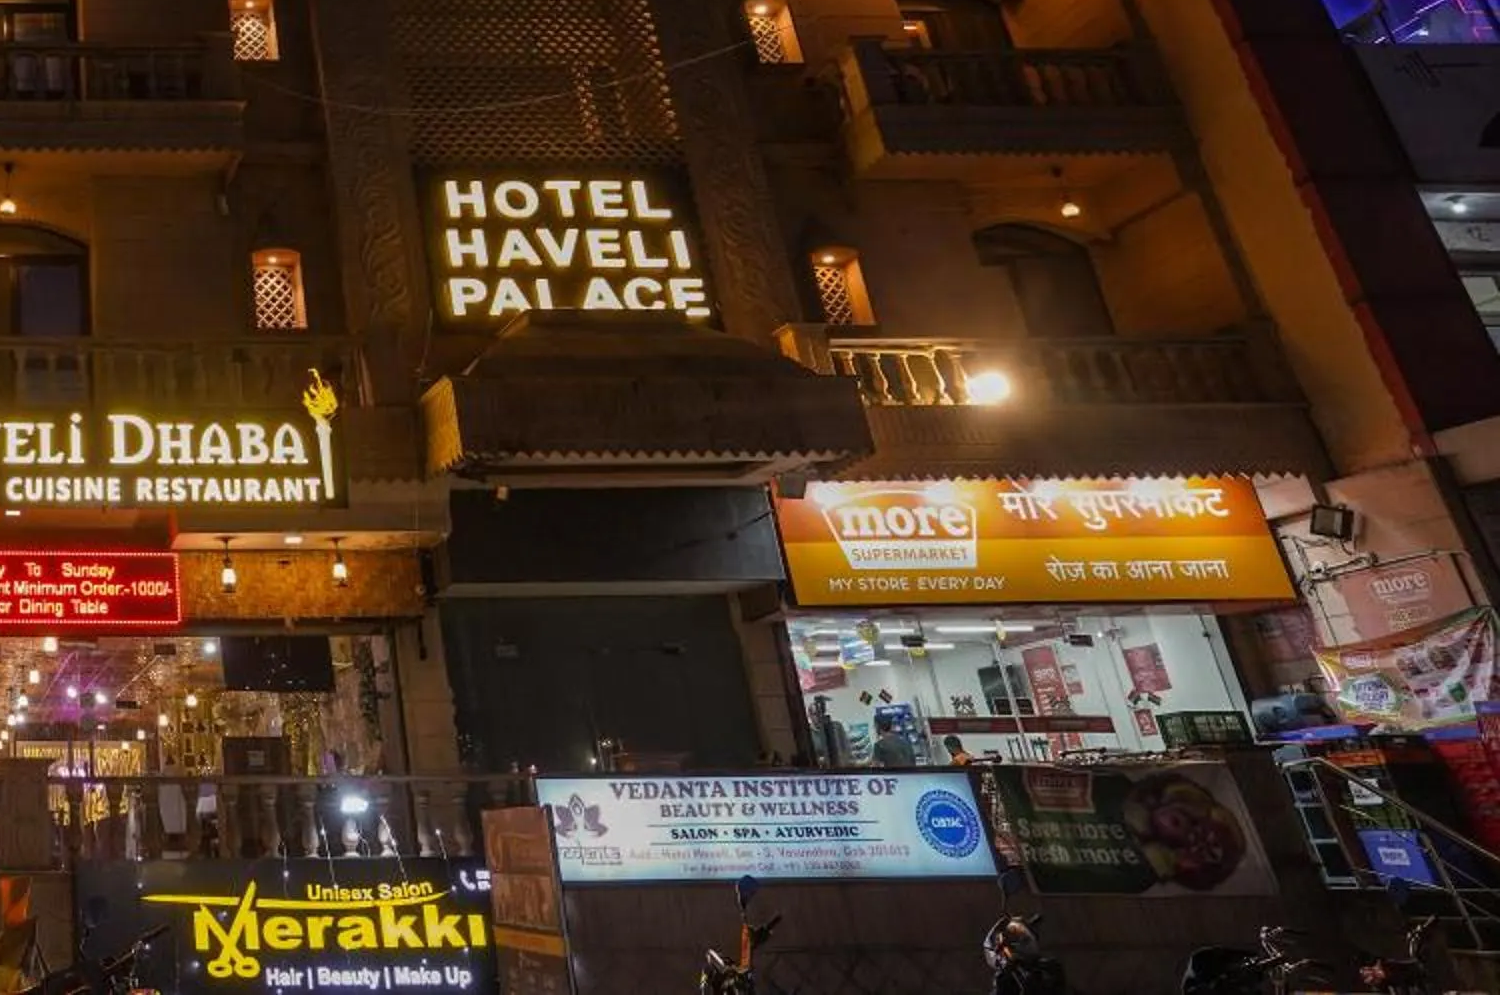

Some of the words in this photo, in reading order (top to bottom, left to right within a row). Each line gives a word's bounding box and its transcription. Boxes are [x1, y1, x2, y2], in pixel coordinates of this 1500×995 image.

[444, 180, 673, 219] HOTEL
[445, 228, 691, 269] HAVELI
[449, 277, 711, 316] PALACE
[107, 413, 309, 466] DHABA
[5, 477, 121, 501] CUISINE
[136, 477, 321, 502] RESTAURANT
[836, 504, 969, 537] more
[850, 546, 969, 563] SUPERMARKET
[24, 562, 42, 577] To
[61, 562, 116, 581] Sunday
[1089, 560, 1120, 580] का
[1125, 560, 1174, 580] आना
[1176, 559, 1230, 580] जाना
[14, 581, 77, 596] Minimum
[829, 577, 853, 592] MY
[858, 577, 910, 592] STORE
[918, 576, 969, 592] EVERY
[973, 575, 1006, 591] DAY
[19, 599, 64, 618] Dining
[71, 600, 109, 615] Table
[609, 780, 728, 801] VEDANTA
[732, 778, 863, 798] INSTITUTE
[867, 778, 899, 796] OF
[660, 802, 736, 818] BEAUTY
[741, 804, 756, 817] &
[760, 800, 860, 817] WELLNESS
[671, 828, 719, 840] SALON
[733, 827, 761, 839] SPA
[775, 826, 860, 839] AYURVEDIC
[307, 883, 374, 901] Unisex
[377, 881, 434, 900] Salon
[193, 904, 487, 951] Merakki
[265, 966, 304, 987] Hair
[317, 966, 381, 990] Beauty
[394, 966, 442, 986] Make
[444, 966, 472, 989] Up
